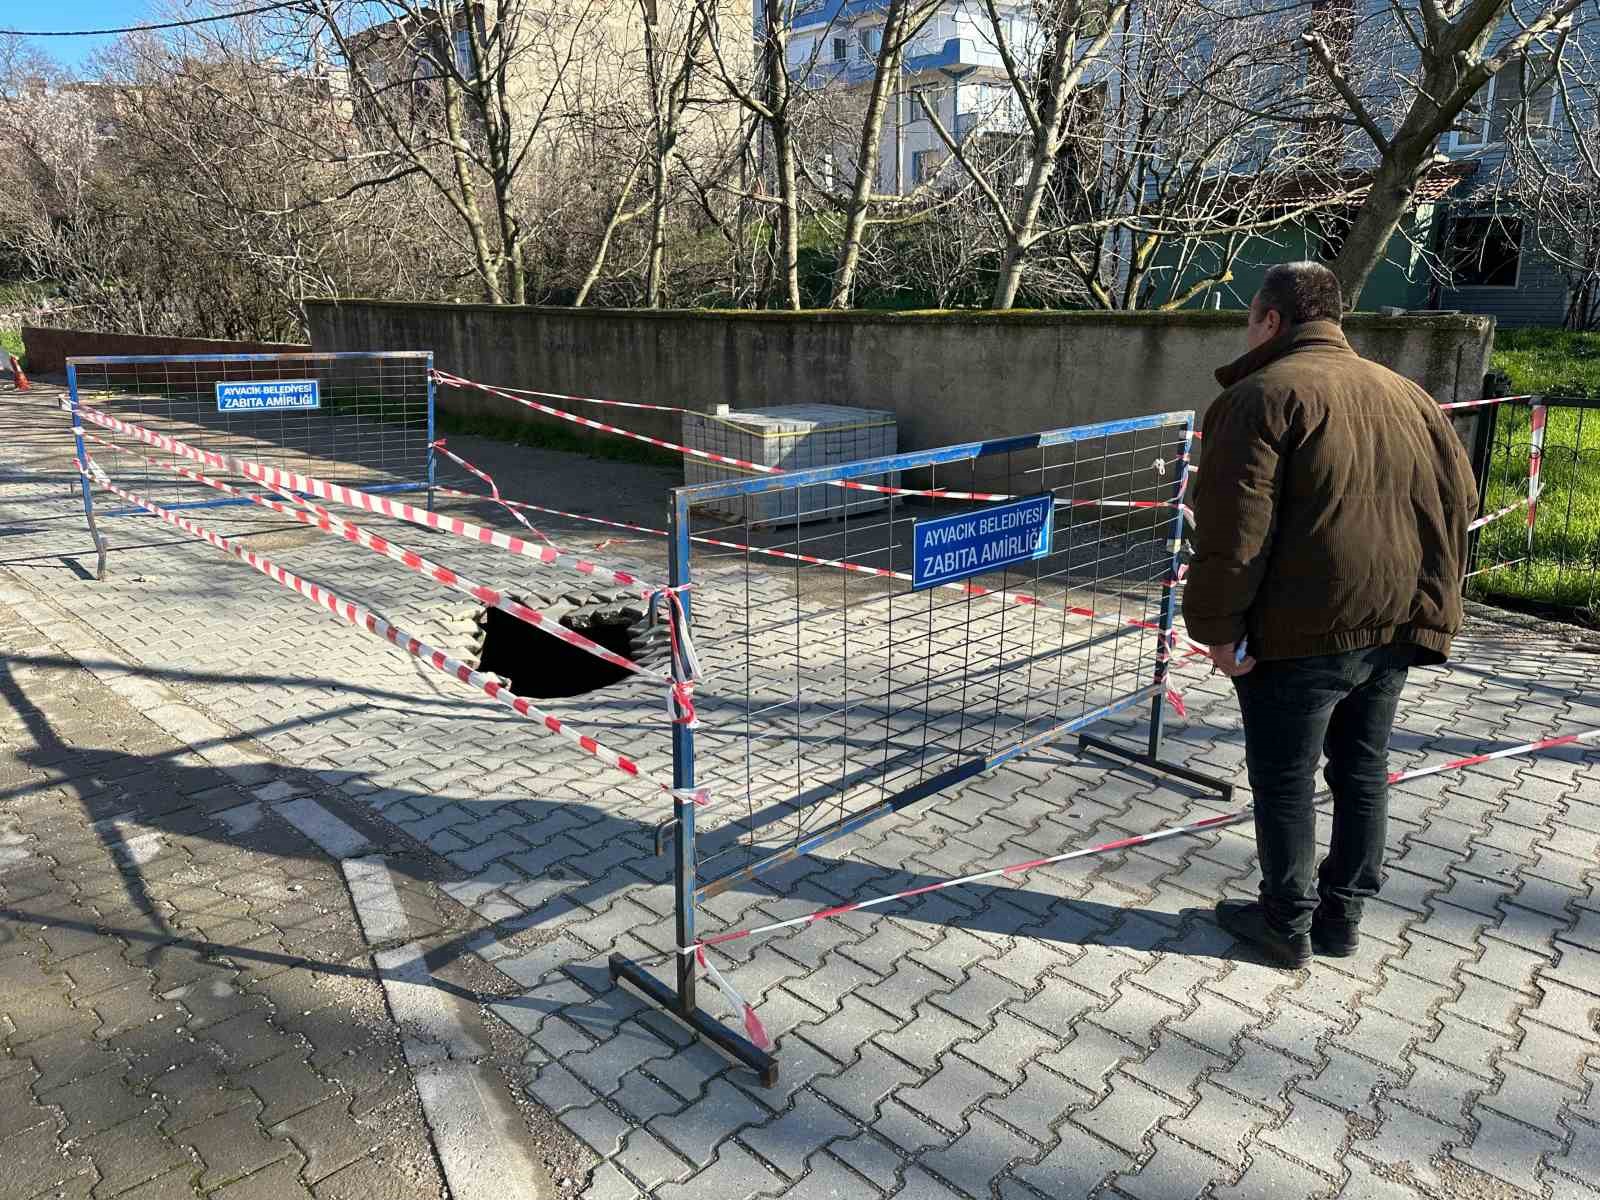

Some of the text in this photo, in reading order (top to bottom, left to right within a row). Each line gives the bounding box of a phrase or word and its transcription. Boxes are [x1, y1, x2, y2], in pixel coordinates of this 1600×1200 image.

[224, 384, 312, 396] AYVACIK BELEDİYESİ
[225, 394, 313, 408] ZABITA AMİRLİĞİ
[924, 503, 1043, 549] AYVACIK BELEDİYESİ
[923, 526, 1043, 578] ZABITA AMİRLİĞİ
